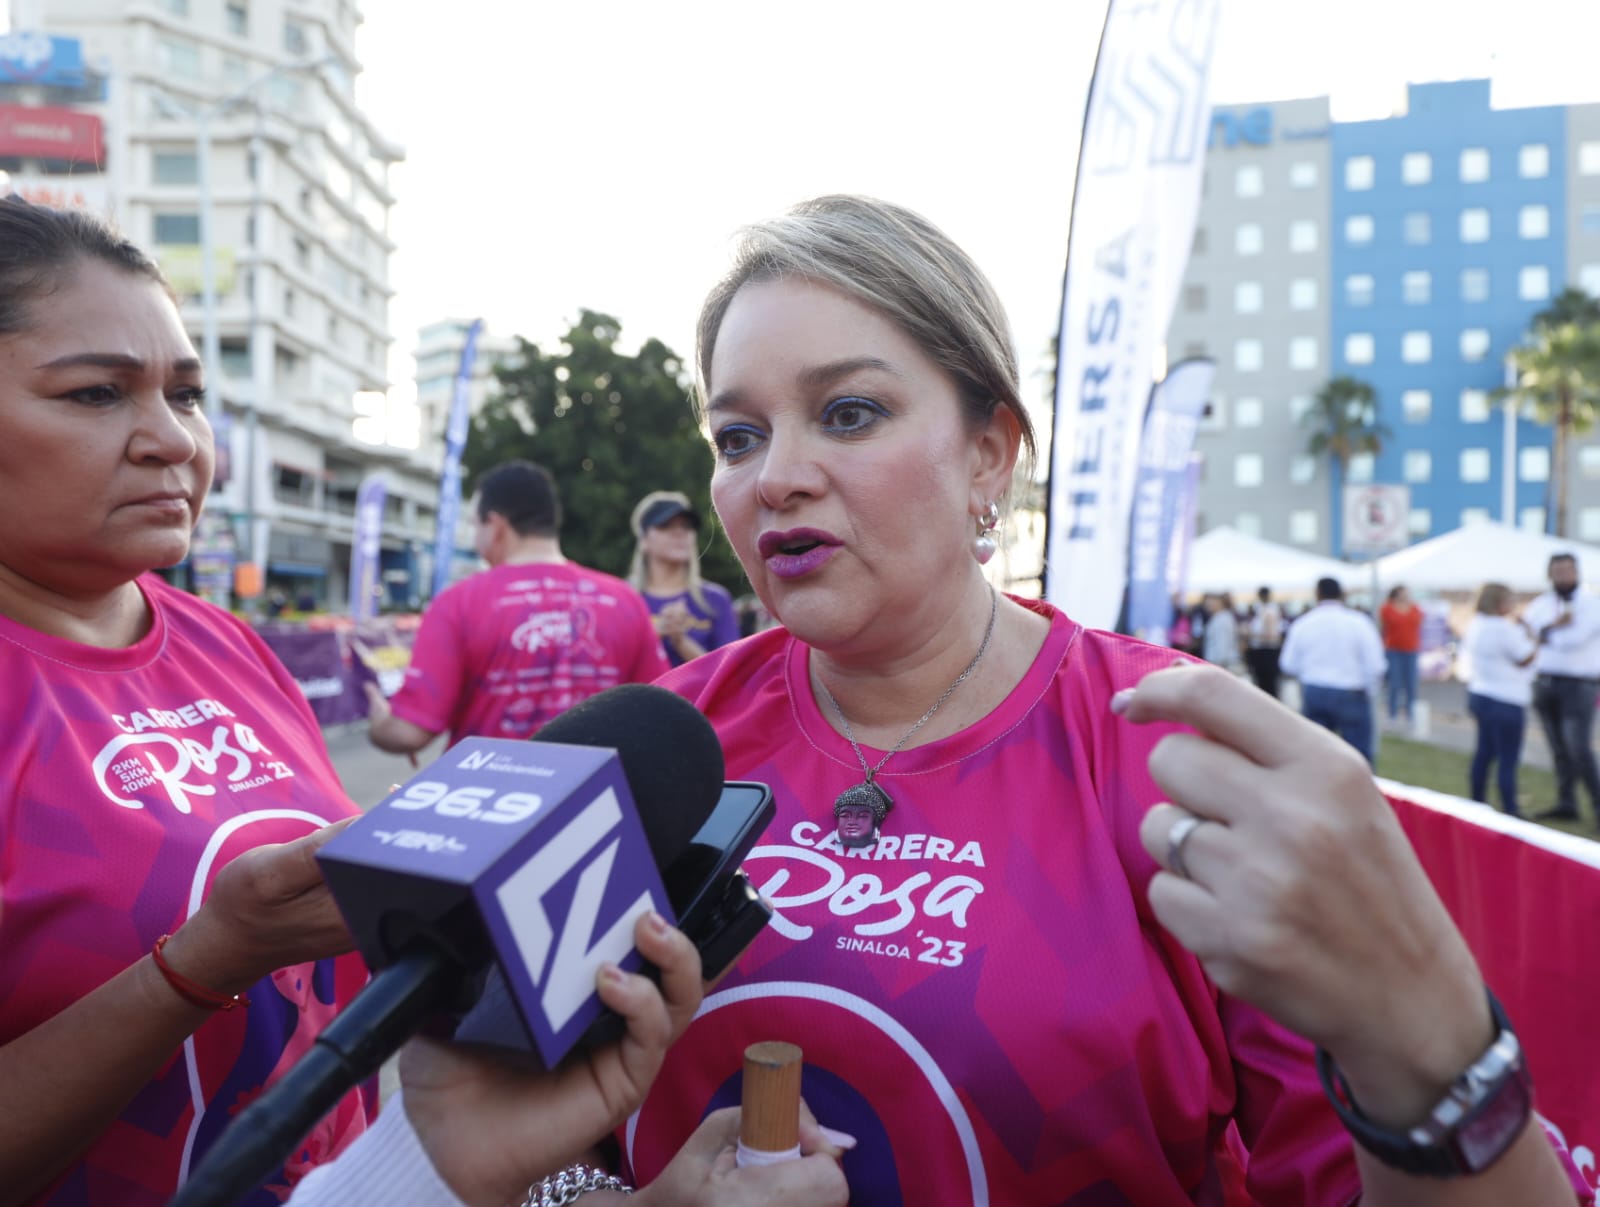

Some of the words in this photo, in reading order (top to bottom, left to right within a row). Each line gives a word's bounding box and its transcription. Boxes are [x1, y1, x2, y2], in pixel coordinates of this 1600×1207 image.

[1067, 224, 1138, 541] HERSA
[112, 699, 236, 733] CARRERA
[92, 723, 272, 814] Rosa
[112, 757, 141, 775] 2KM
[120, 766, 150, 784] 5KM
[121, 776, 157, 794] 10KM
[228, 775, 273, 793] SINALOA
[389, 781, 543, 824] 96.9
[744, 845, 984, 940] Rosa
[836, 937, 911, 959] SINALOA
